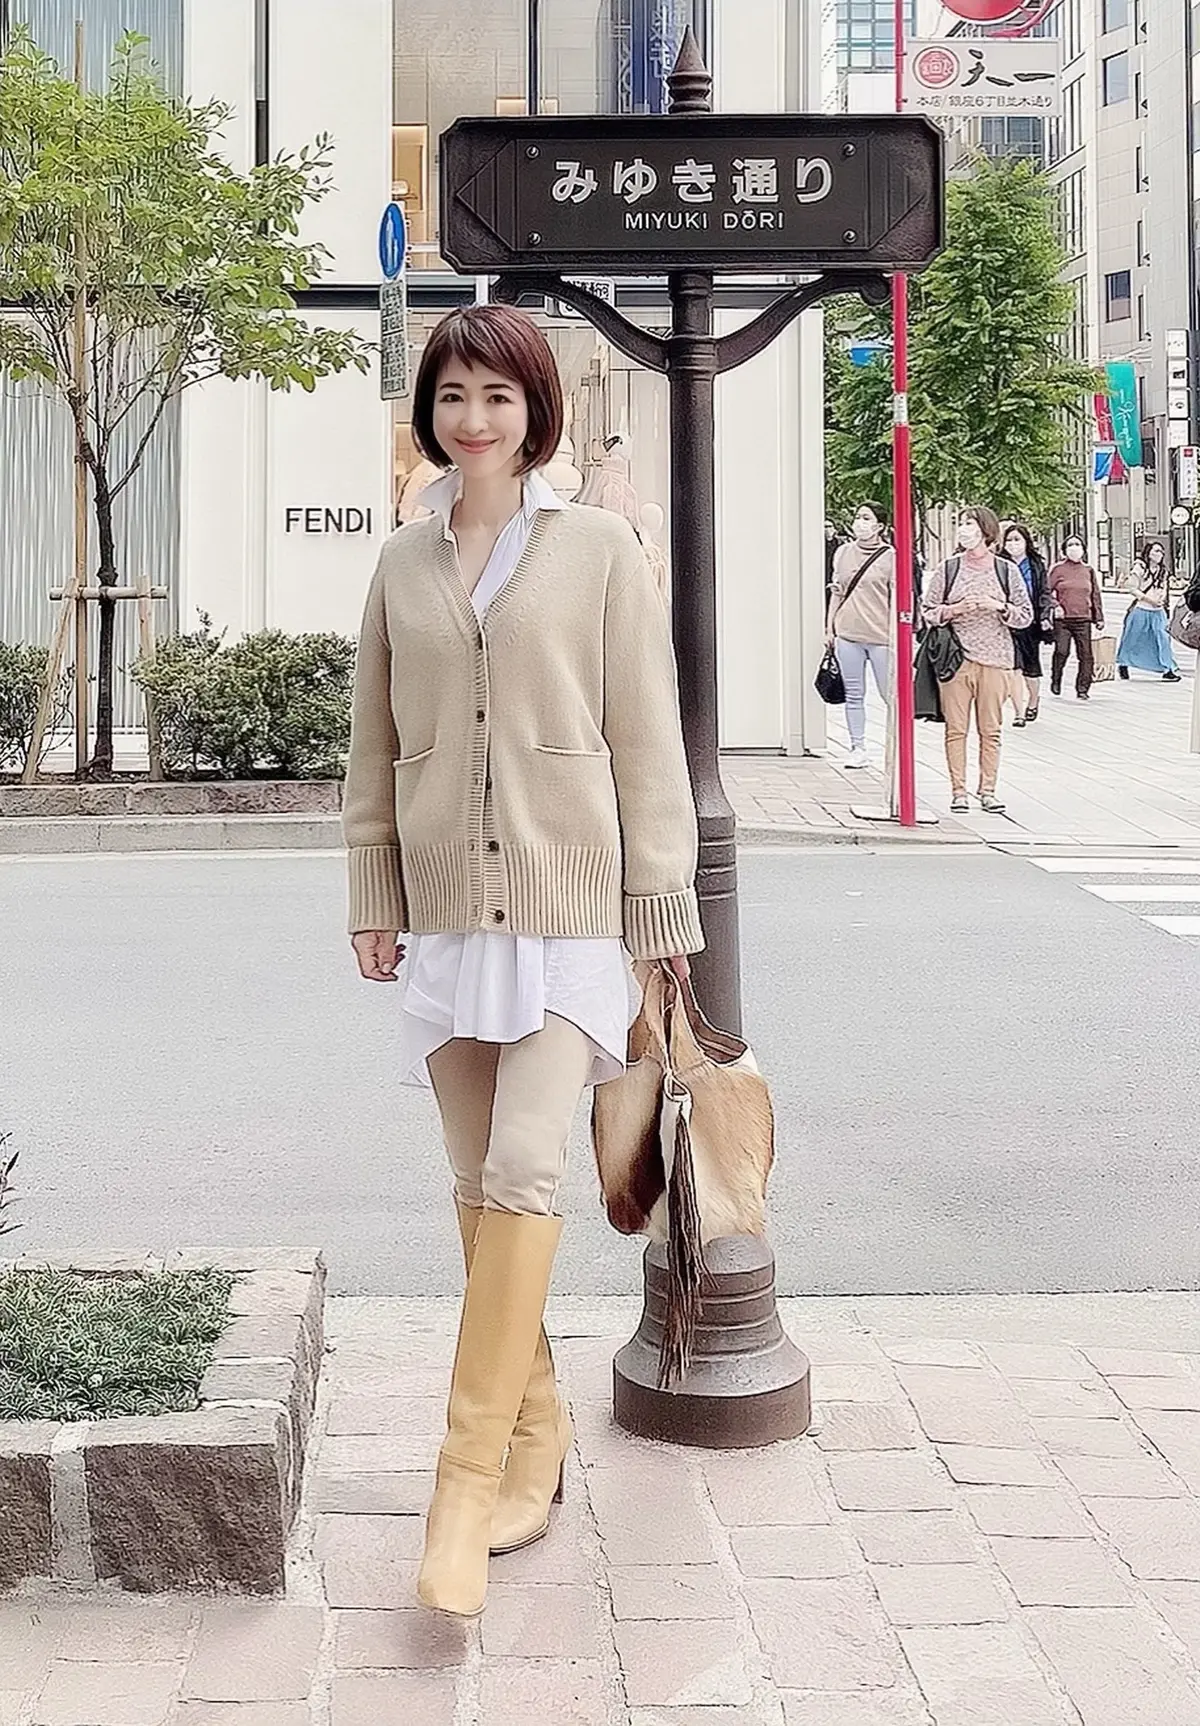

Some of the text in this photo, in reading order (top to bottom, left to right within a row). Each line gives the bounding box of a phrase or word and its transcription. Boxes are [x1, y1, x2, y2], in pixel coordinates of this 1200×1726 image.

[552, 158, 832, 204] みゆき通り
[625, 212, 707, 229] MIYUKI
[286, 508, 371, 534] FENDI
